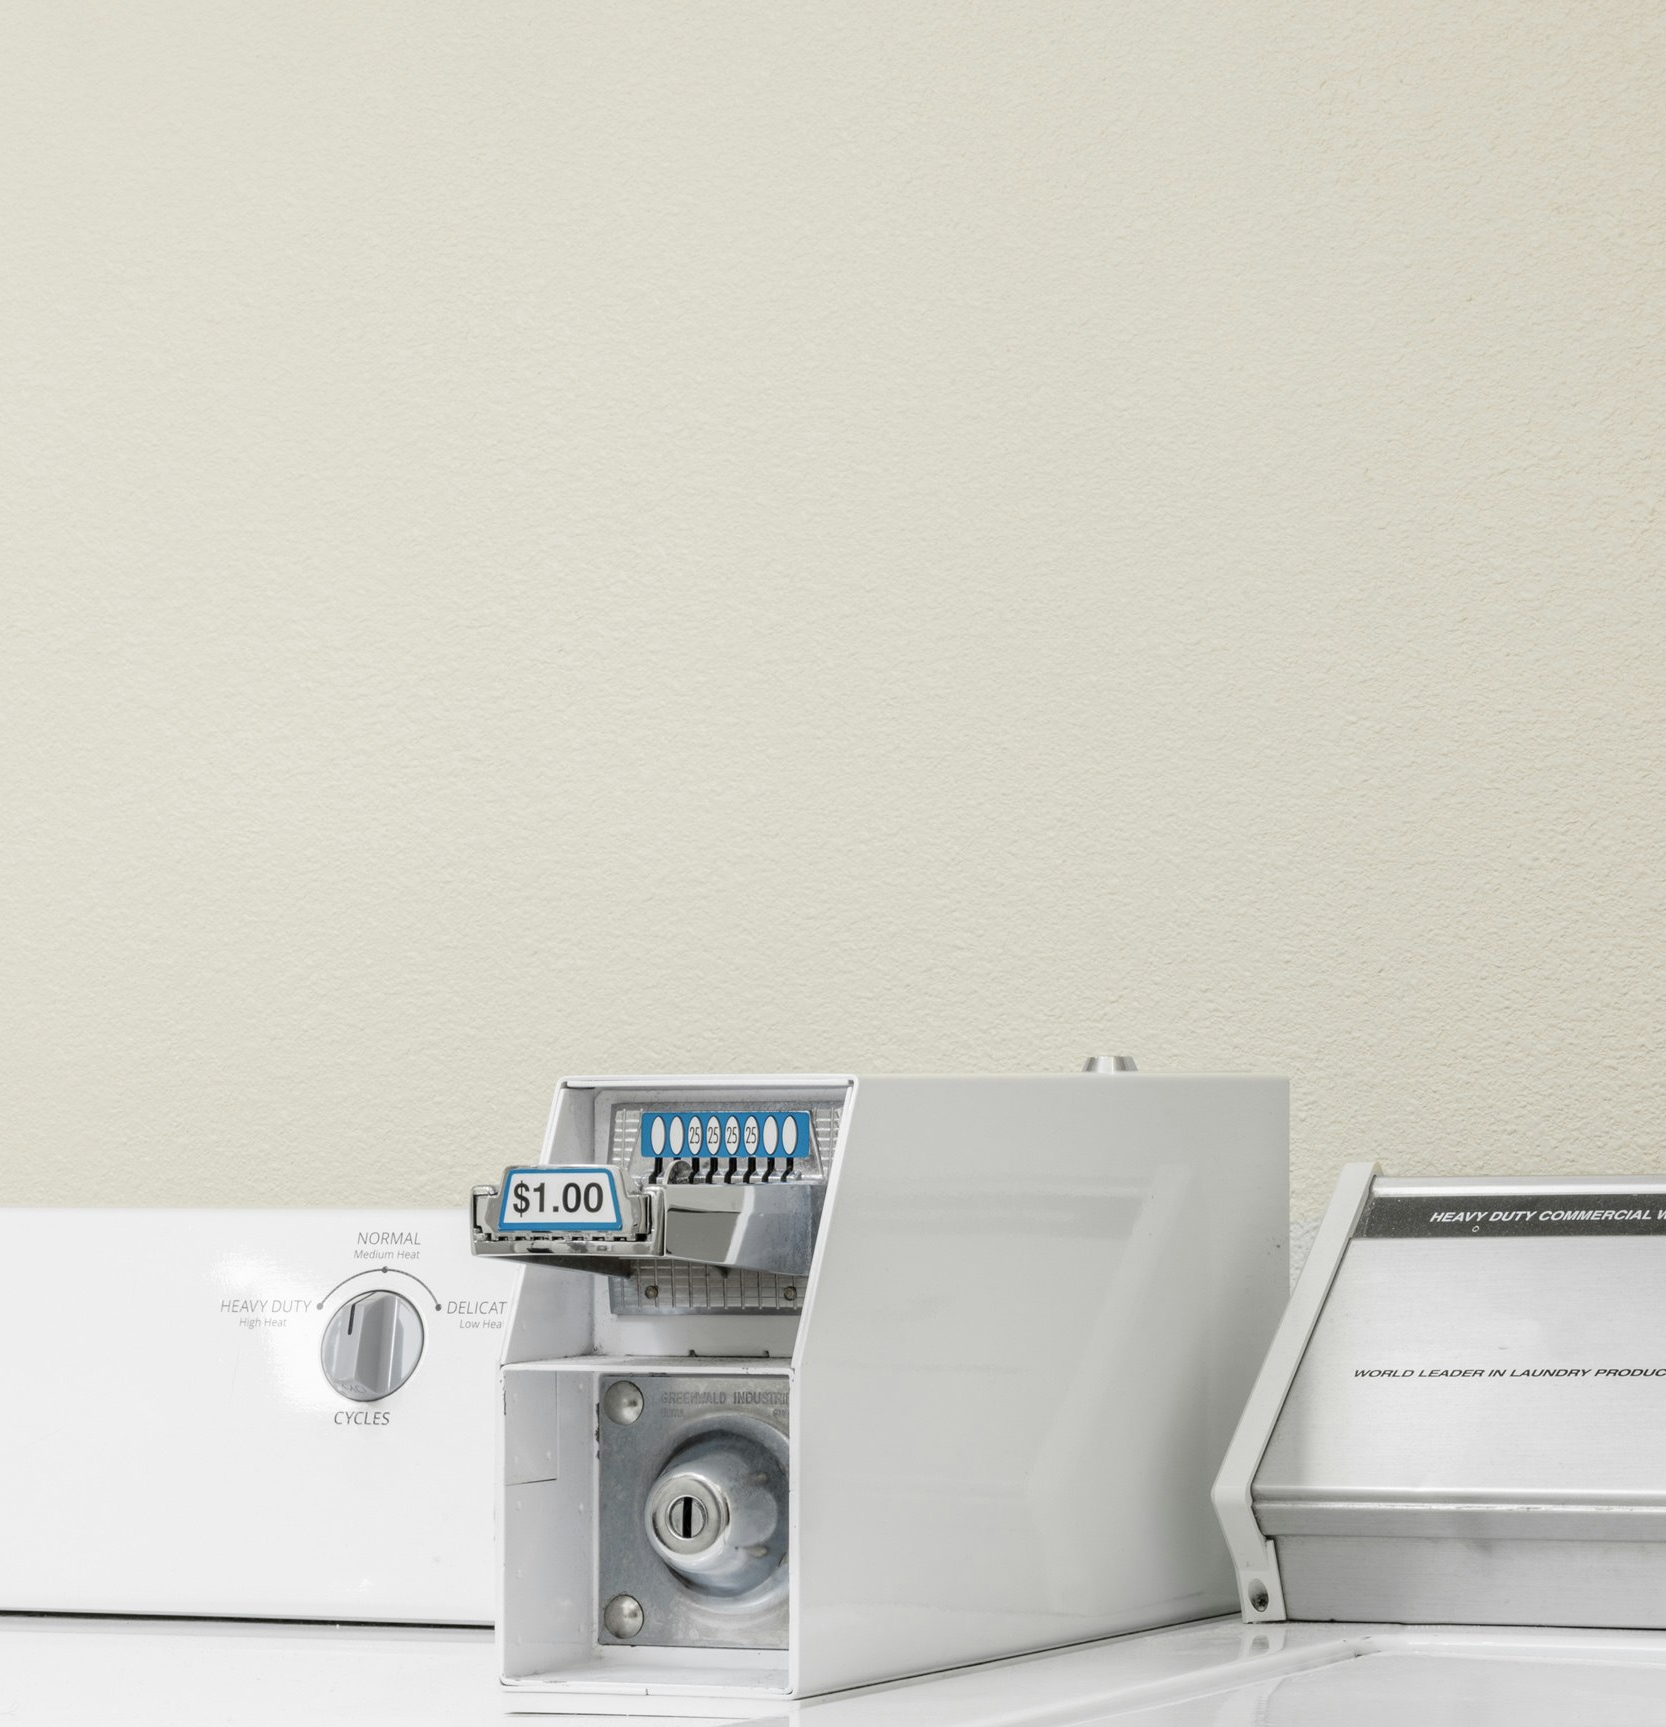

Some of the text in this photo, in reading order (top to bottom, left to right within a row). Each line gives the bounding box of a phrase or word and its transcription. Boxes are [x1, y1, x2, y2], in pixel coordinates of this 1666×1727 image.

[690, 1127, 757, 1144] 25 25 25 25
[513, 1180, 604, 1217] $1.00
[1430, 1211, 1489, 1222] HEAVY
[1489, 1211, 1536, 1222] DUTY
[1539, 1210, 1652, 1221] COMMERCIAL
[357, 1232, 421, 1245] NORMAL
[354, 1250, 420, 1259] Medium Heat
[220, 1300, 312, 1313] HEAVY DUTY
[447, 1301, 507, 1314] DELICAT
[239, 1318, 287, 1328] High Heat
[459, 1320, 503, 1328] Low Hea
[1354, 1369, 1415, 1377] WORLD
[1418, 1369, 1485, 1377] LEADER
[1488, 1369, 1507, 1377] IN
[1510, 1368, 1590, 1377] LAUNDRY
[334, 1411, 390, 1426] CYCLES
